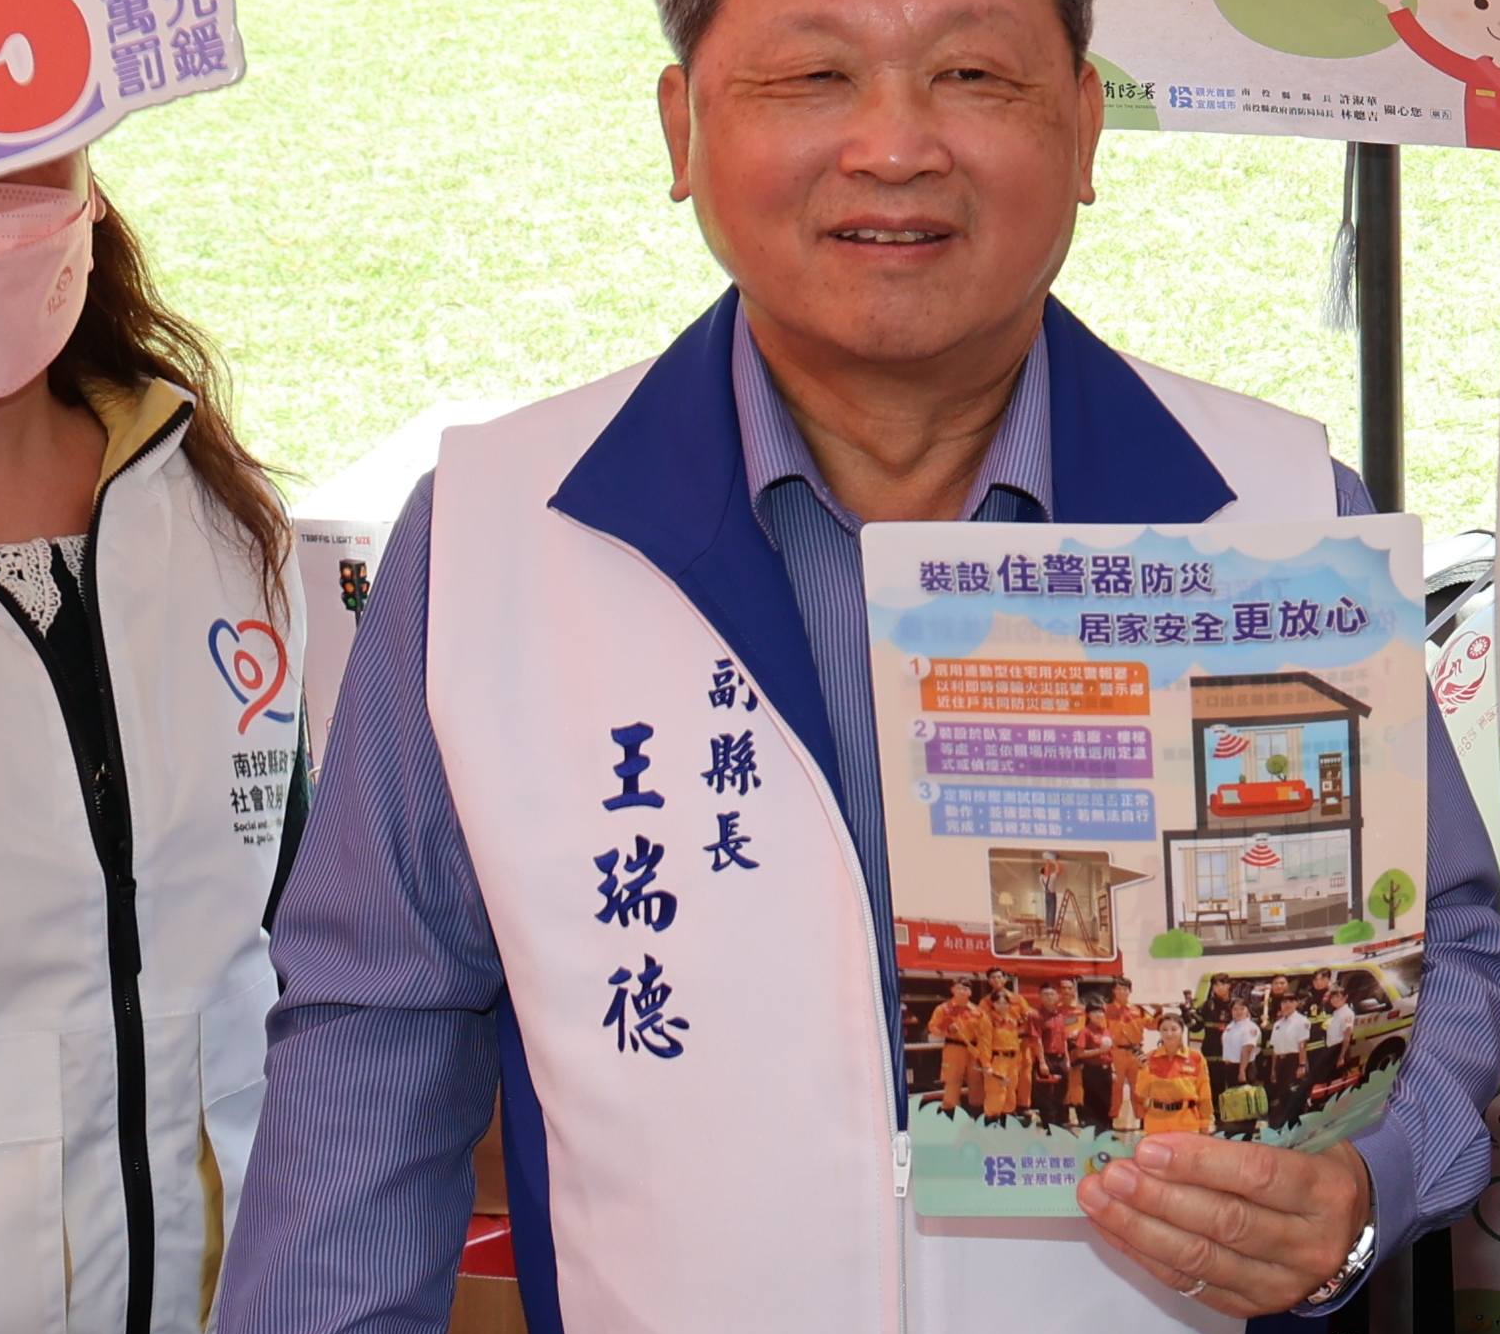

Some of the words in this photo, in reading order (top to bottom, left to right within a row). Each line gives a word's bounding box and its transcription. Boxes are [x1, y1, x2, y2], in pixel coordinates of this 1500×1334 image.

[919, 552, 1214, 597] 裝設住警器防災
[1078, 595, 1368, 646] 居家安全更放心
[699, 658, 762, 873] 副縣長
[593, 720, 691, 1060] 王瑞德
